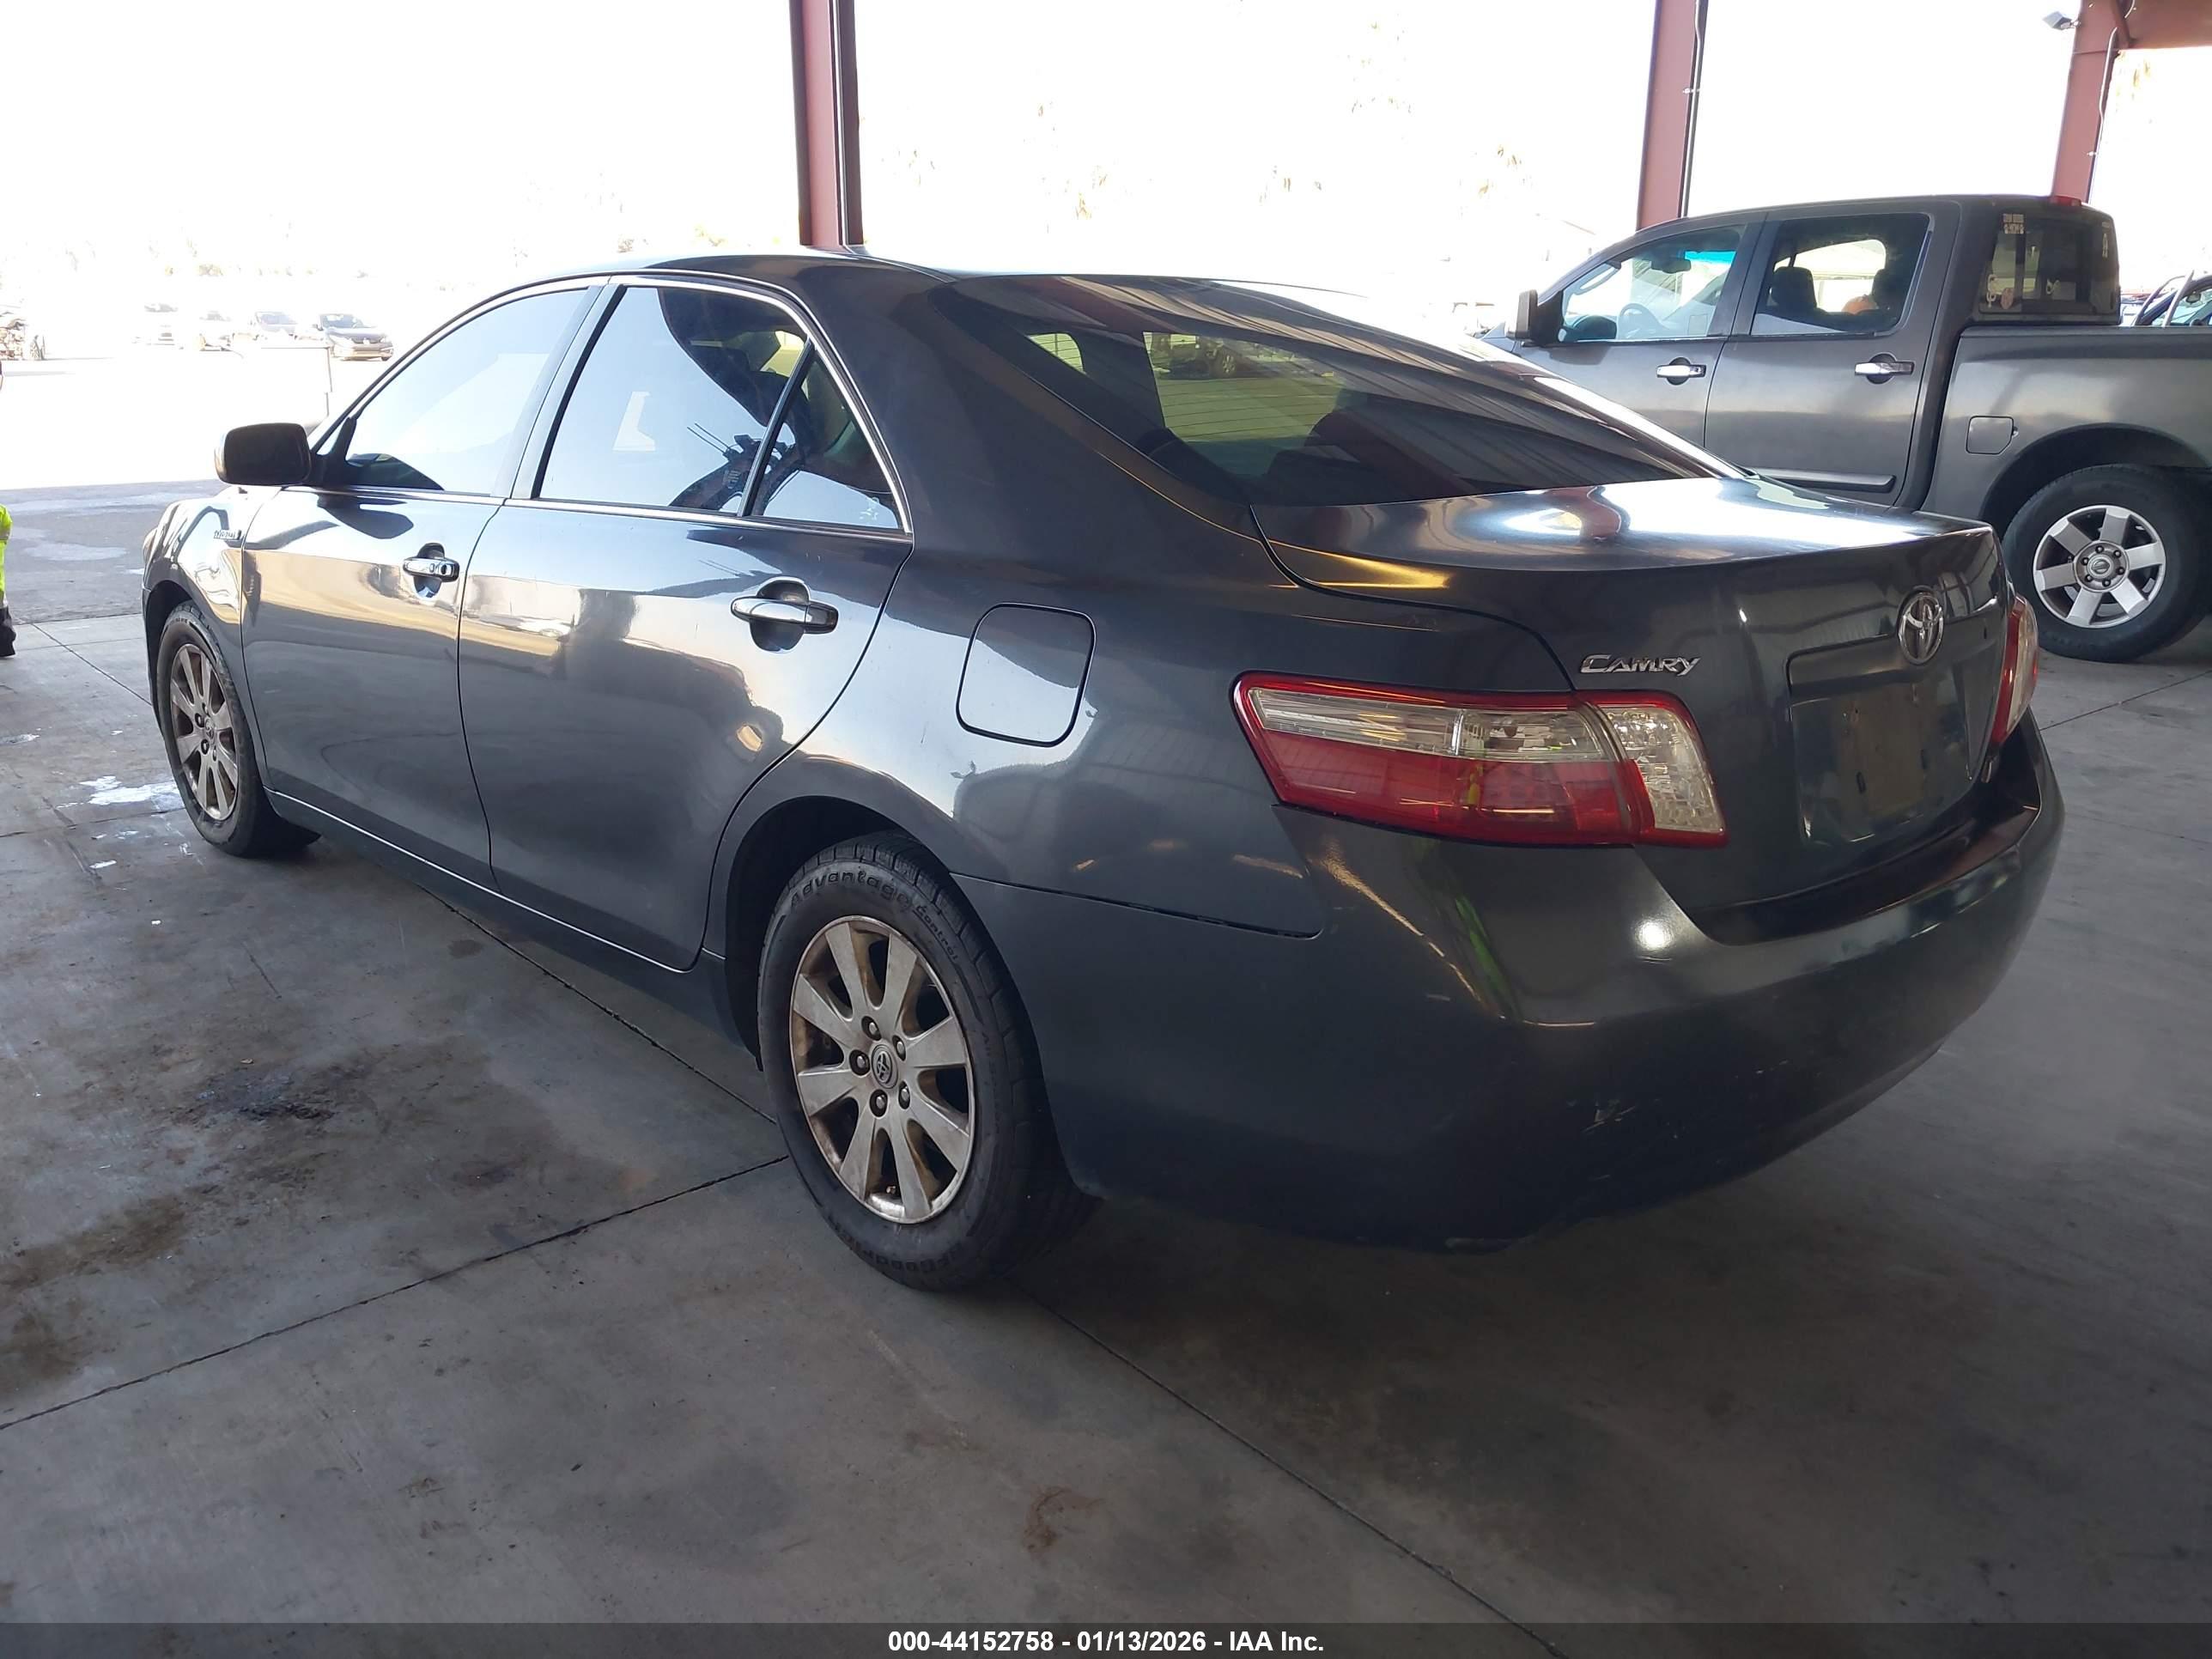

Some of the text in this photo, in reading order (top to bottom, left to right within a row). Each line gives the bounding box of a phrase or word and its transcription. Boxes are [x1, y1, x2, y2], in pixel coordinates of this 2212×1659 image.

[1580, 654, 1701, 677] CAMRY
[789, 869, 959, 961] Advantage Control
